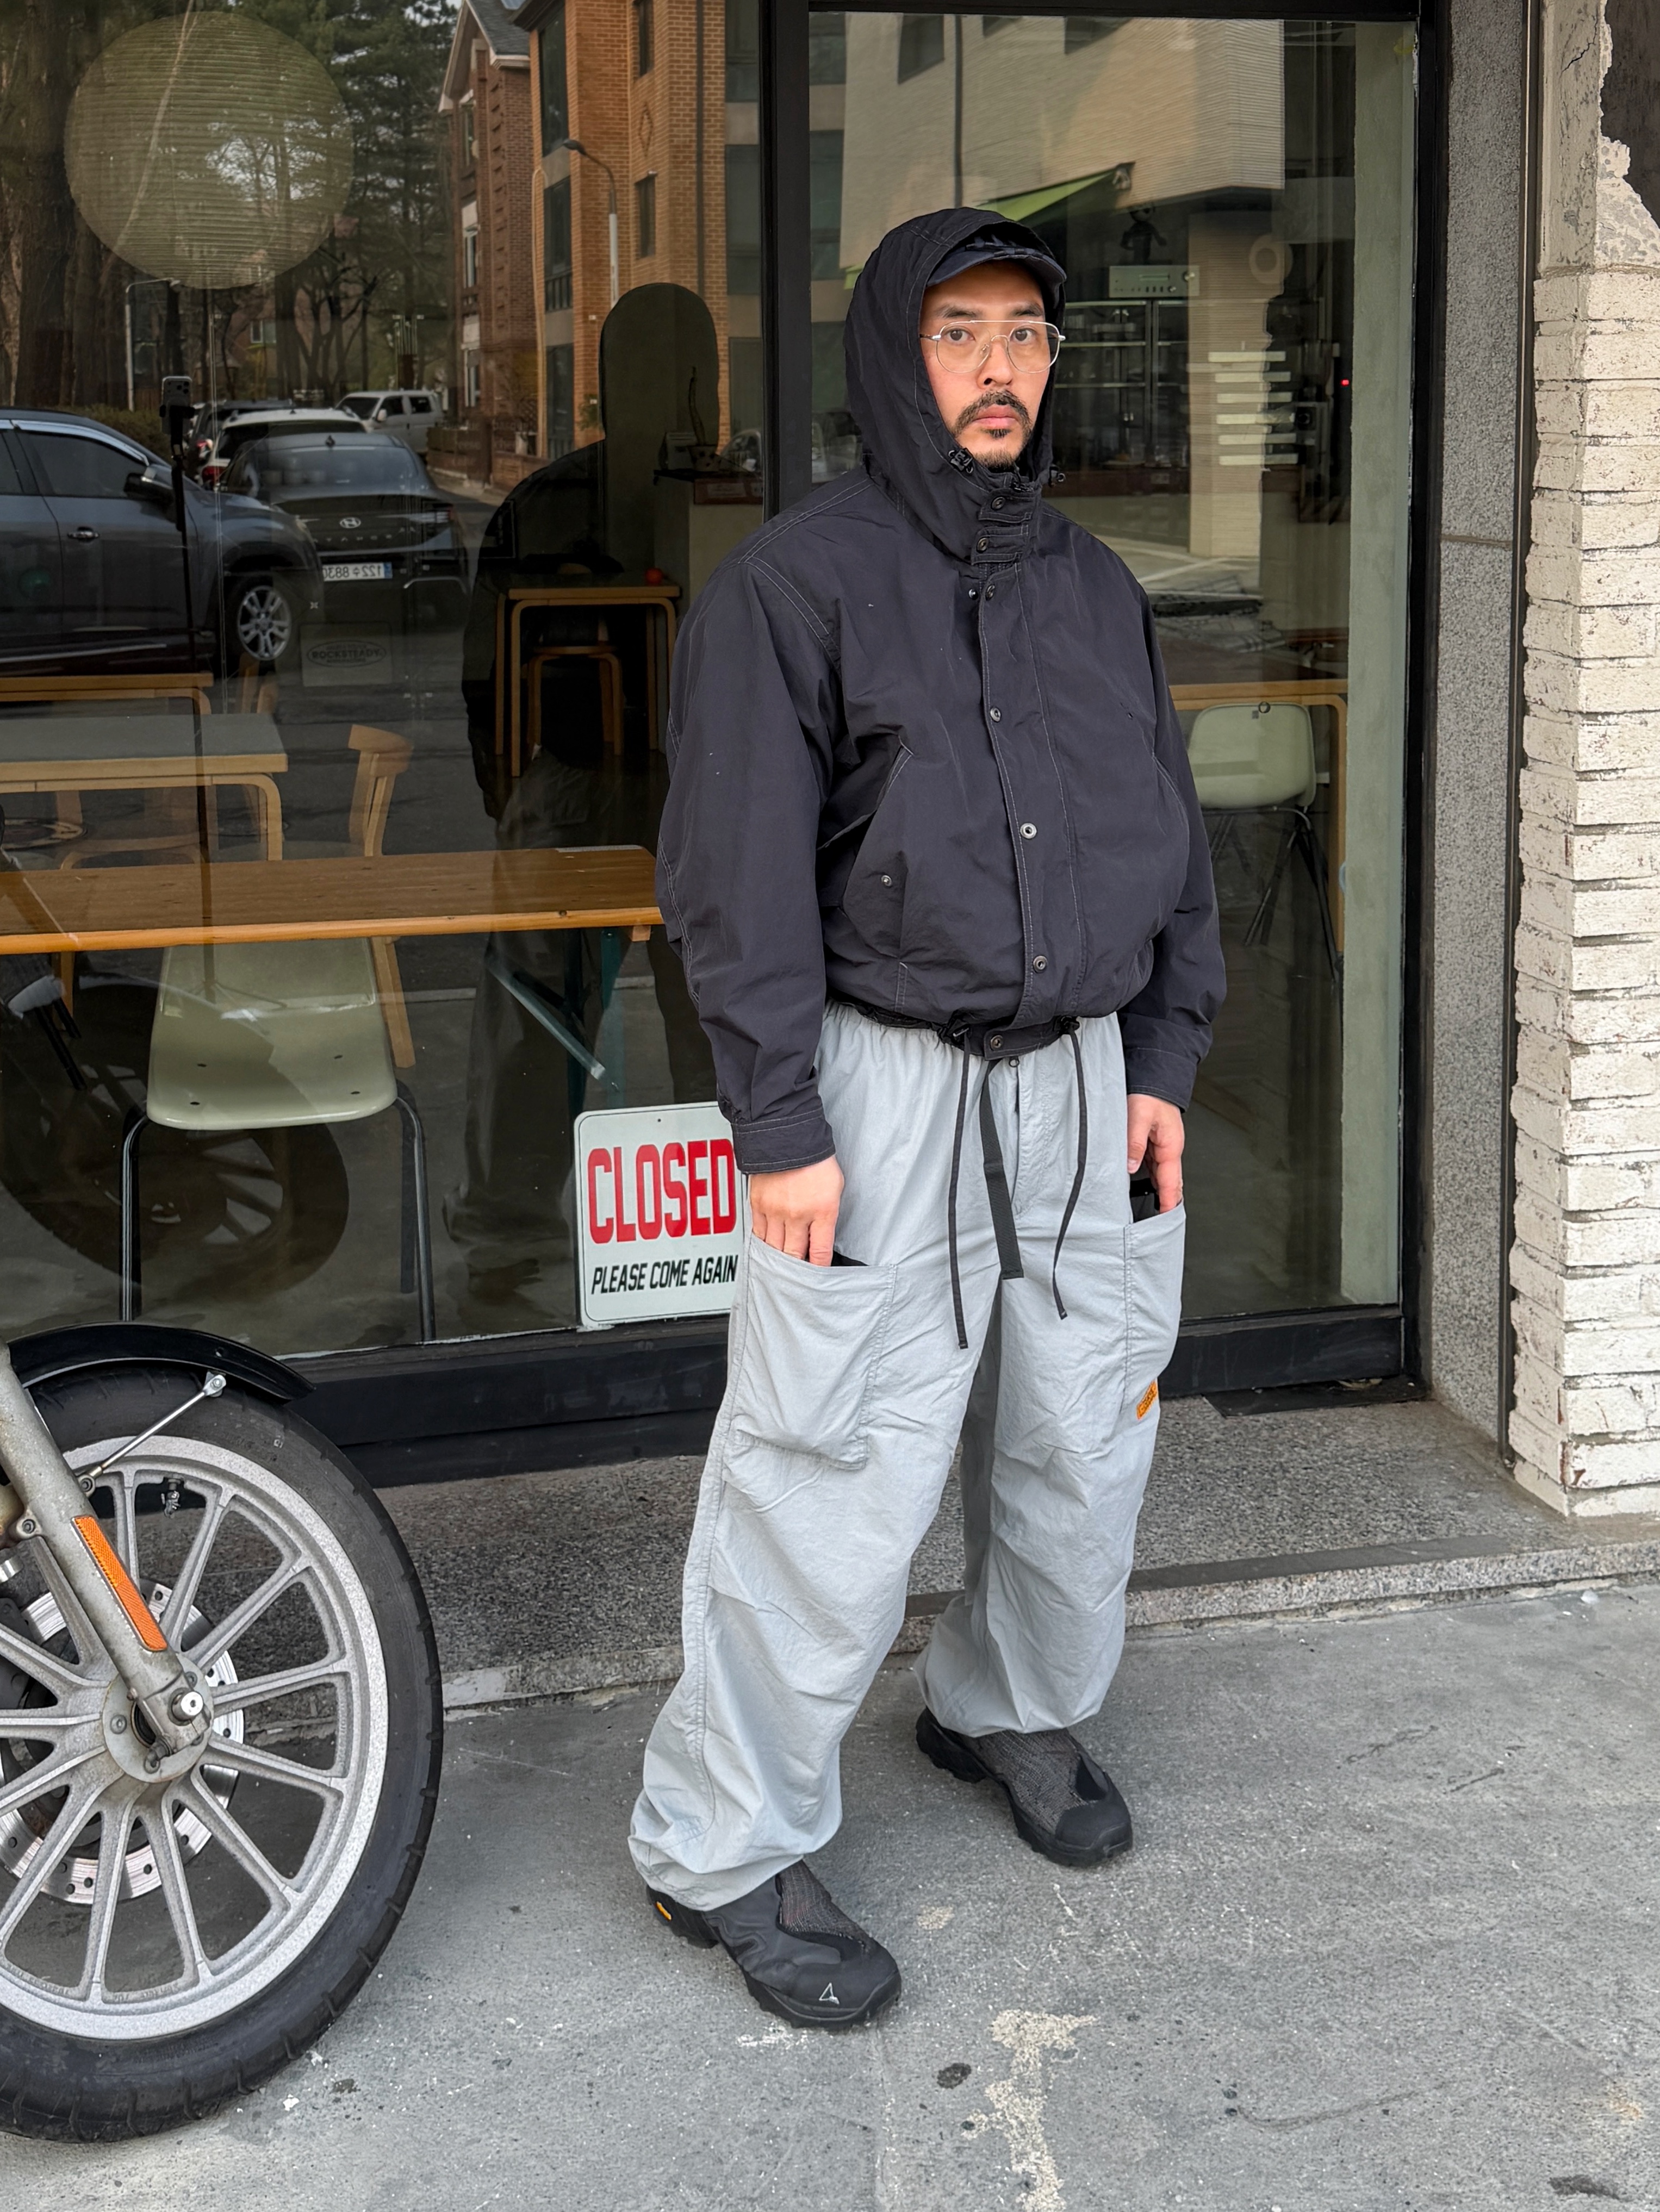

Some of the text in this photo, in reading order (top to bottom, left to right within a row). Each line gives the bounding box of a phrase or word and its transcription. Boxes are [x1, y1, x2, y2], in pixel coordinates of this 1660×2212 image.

[588, 1139, 737, 1244] CLOSED
[591, 1255, 738, 1294] PLEASE COME AGAIN
